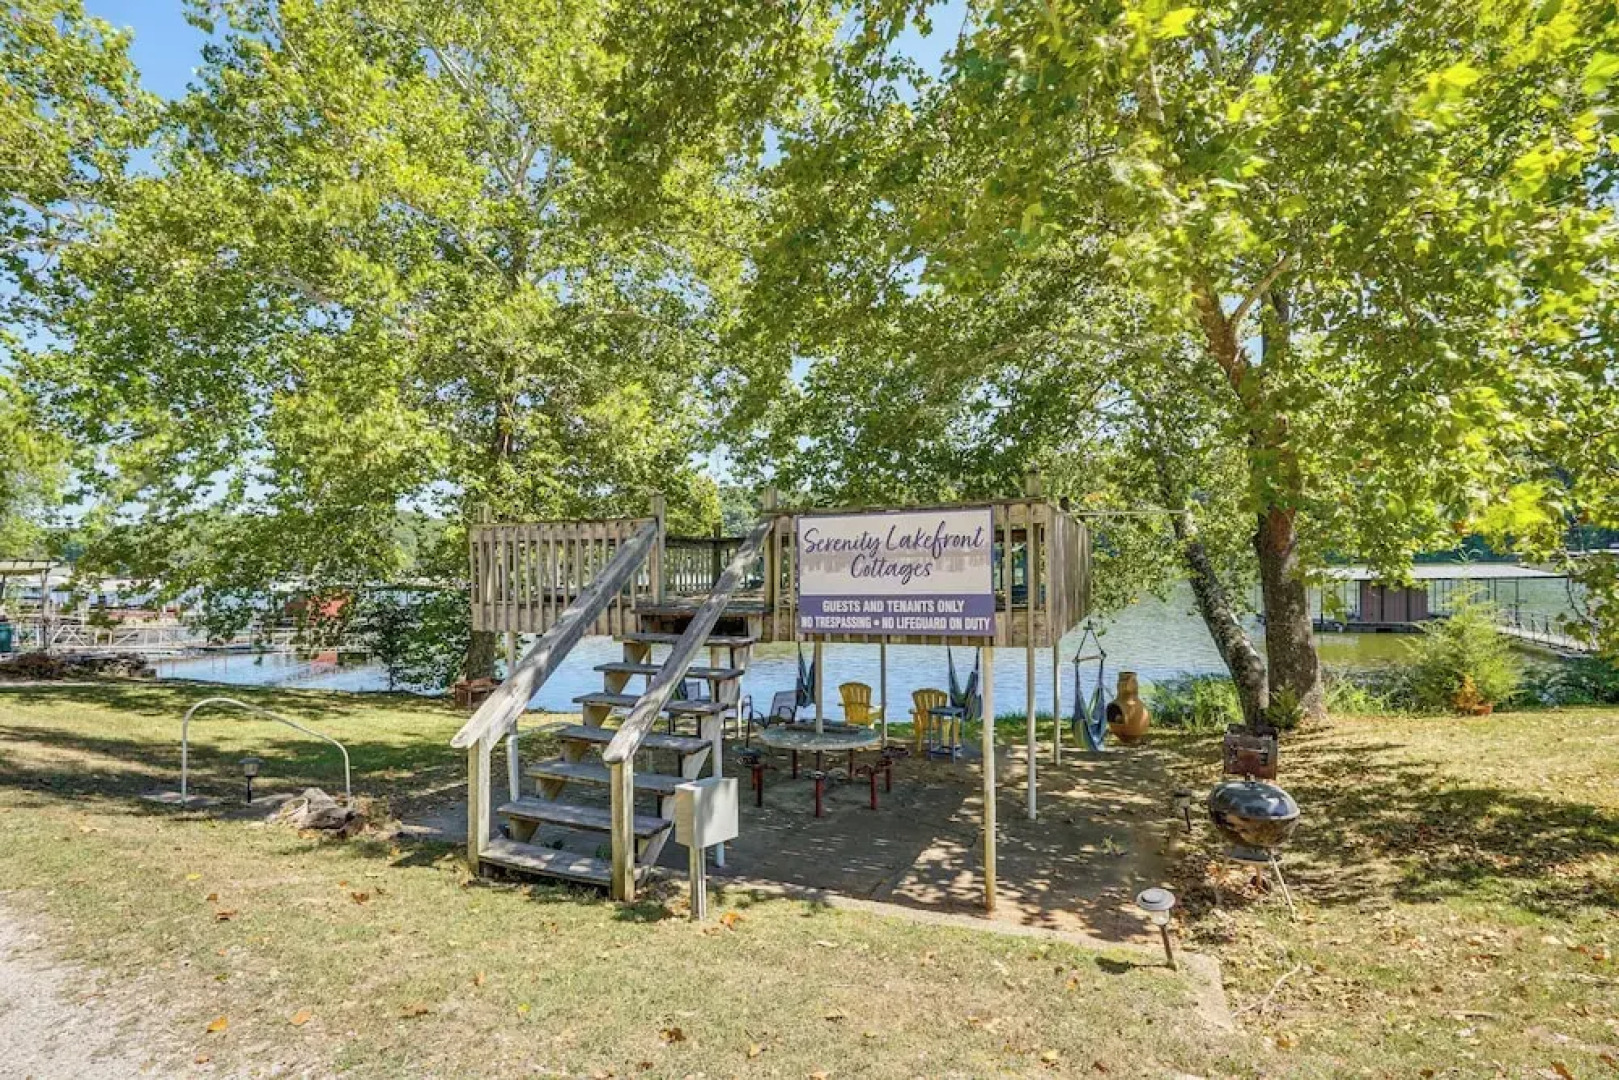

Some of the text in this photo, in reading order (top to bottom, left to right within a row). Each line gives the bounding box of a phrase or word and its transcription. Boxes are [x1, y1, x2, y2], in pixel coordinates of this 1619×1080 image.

[804, 520, 985, 559] Serenity Lakefront
[850, 554, 933, 585] Cottages
[822, 600, 965, 613] GUESTS AND TENANTS ONLY
[801, 617, 991, 631] NO TRESPASSING NO LIFEGUARD ON DUTY
